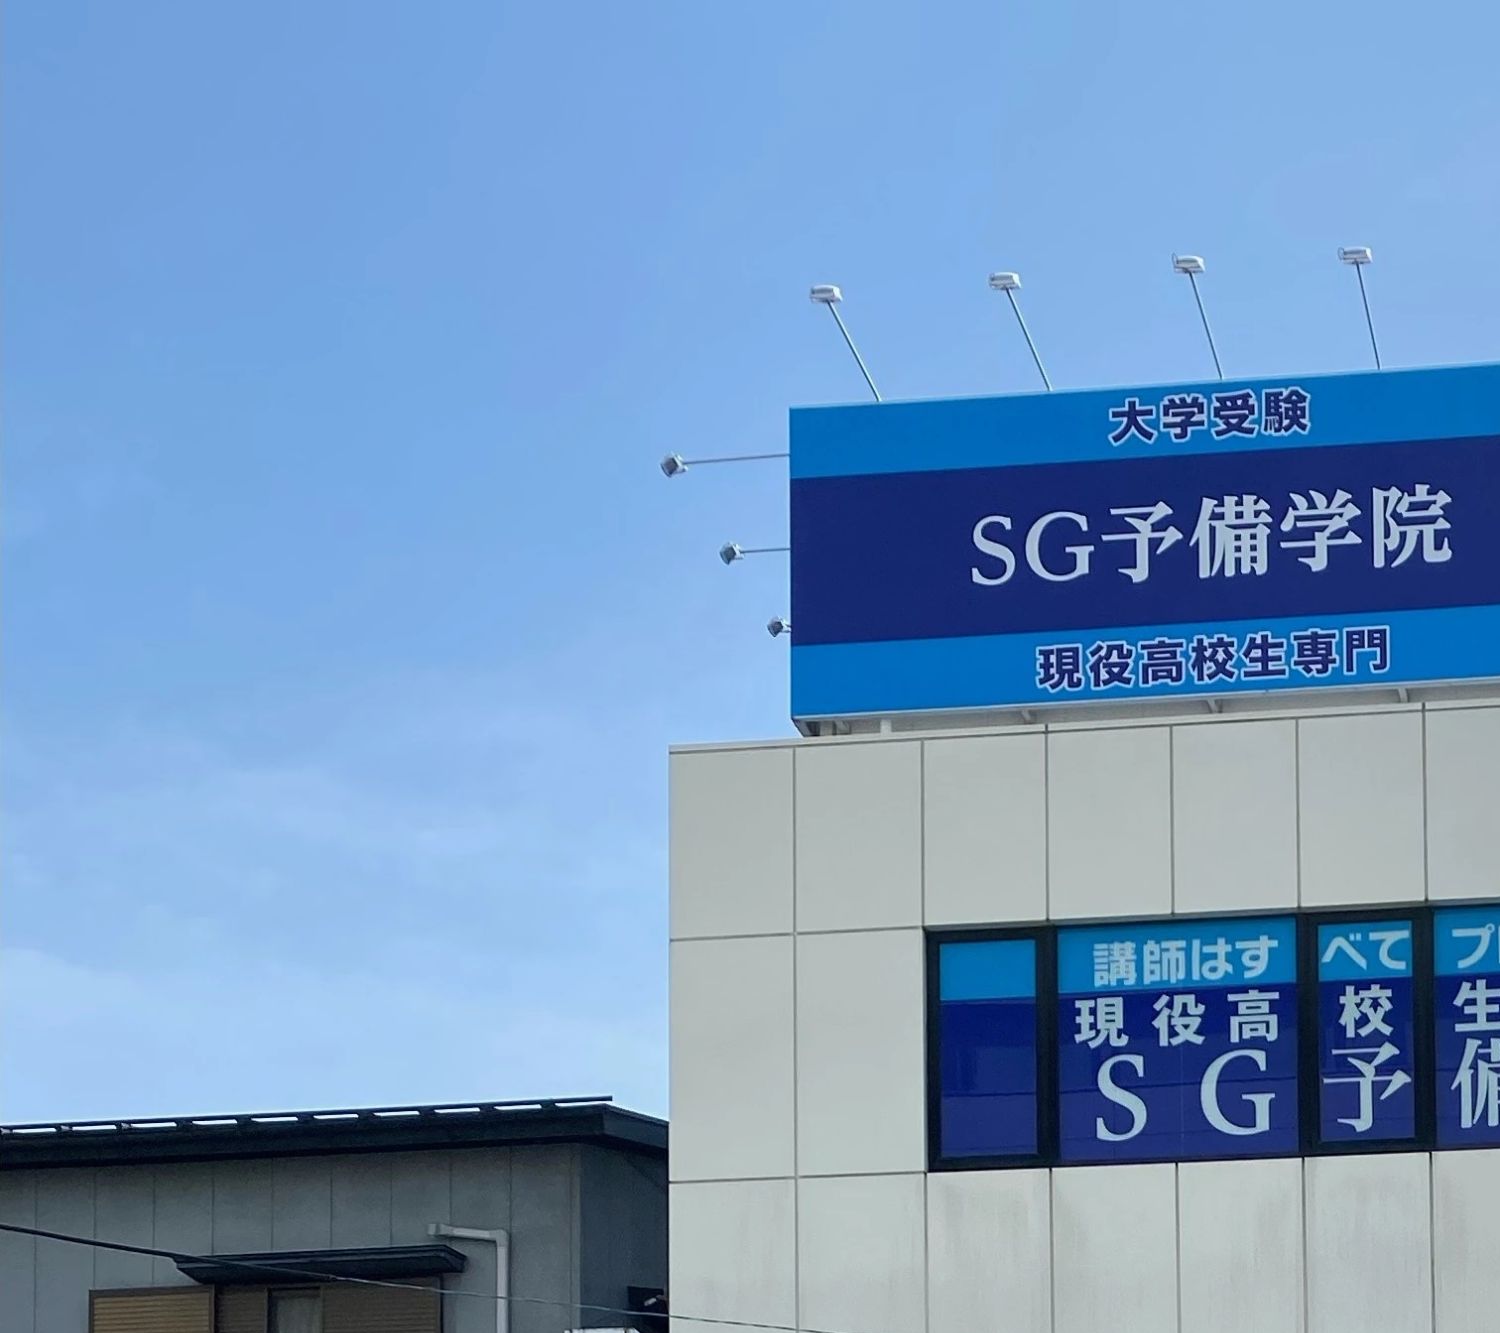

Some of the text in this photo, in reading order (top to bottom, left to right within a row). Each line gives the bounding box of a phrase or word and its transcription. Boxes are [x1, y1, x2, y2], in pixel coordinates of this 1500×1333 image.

[1107, 387, 1312, 447] 大学受験
[970, 482, 1454, 587] SG予備学院
[1035, 625, 1391, 694] 現役高校生専門
